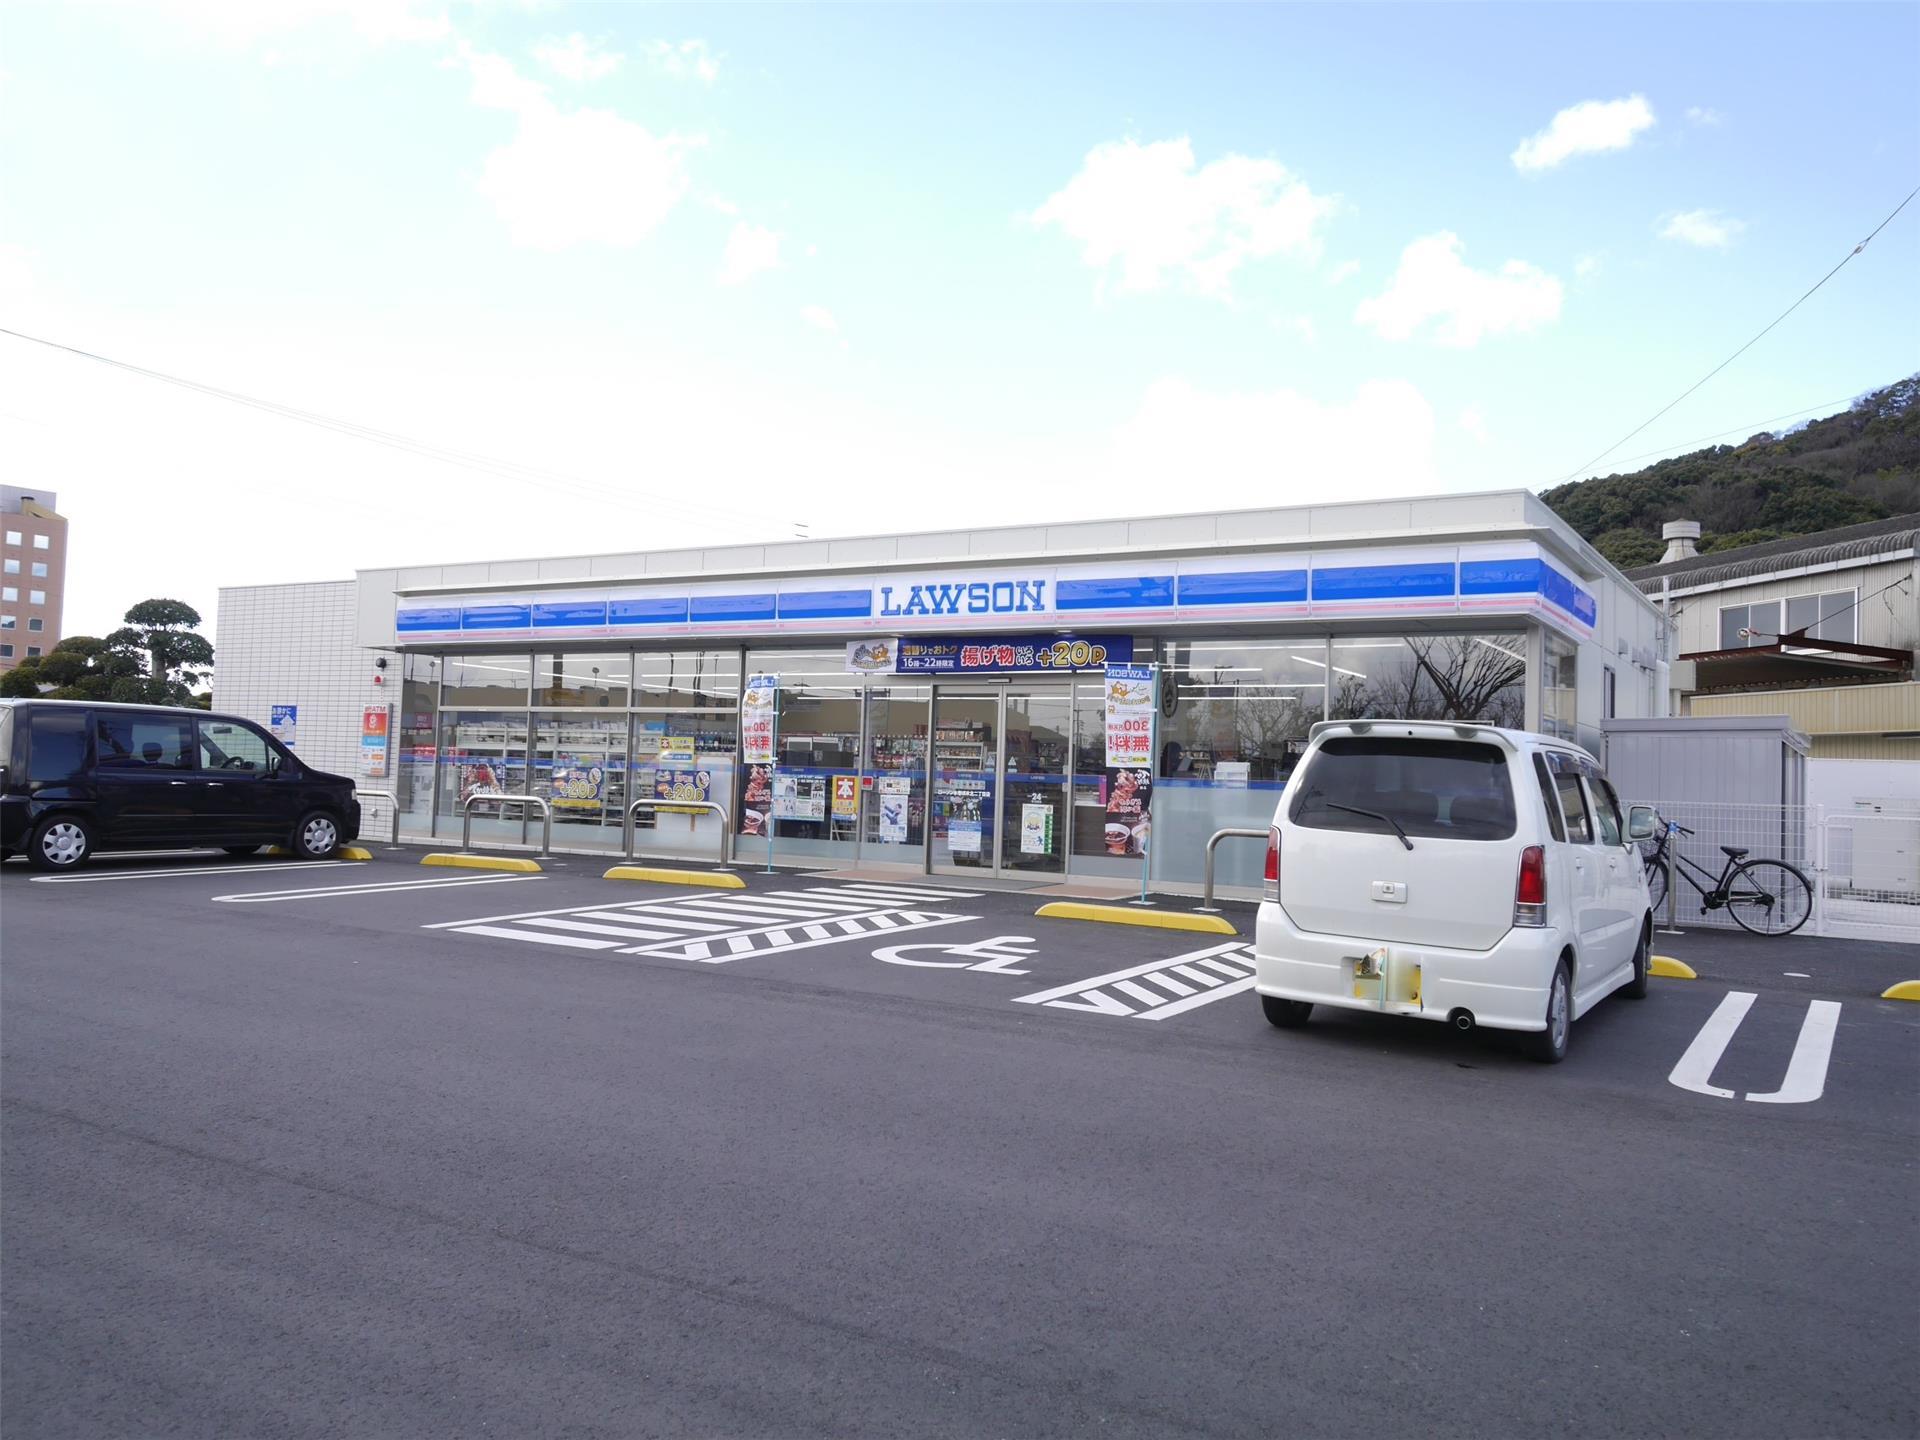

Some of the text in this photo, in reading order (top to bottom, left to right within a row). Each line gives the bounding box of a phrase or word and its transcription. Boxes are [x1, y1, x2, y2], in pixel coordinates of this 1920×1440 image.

[880, 580, 1046, 616] LAWSON
[961, 645, 1015, 667] 揚げ物
[837, 778, 854, 799] 本
